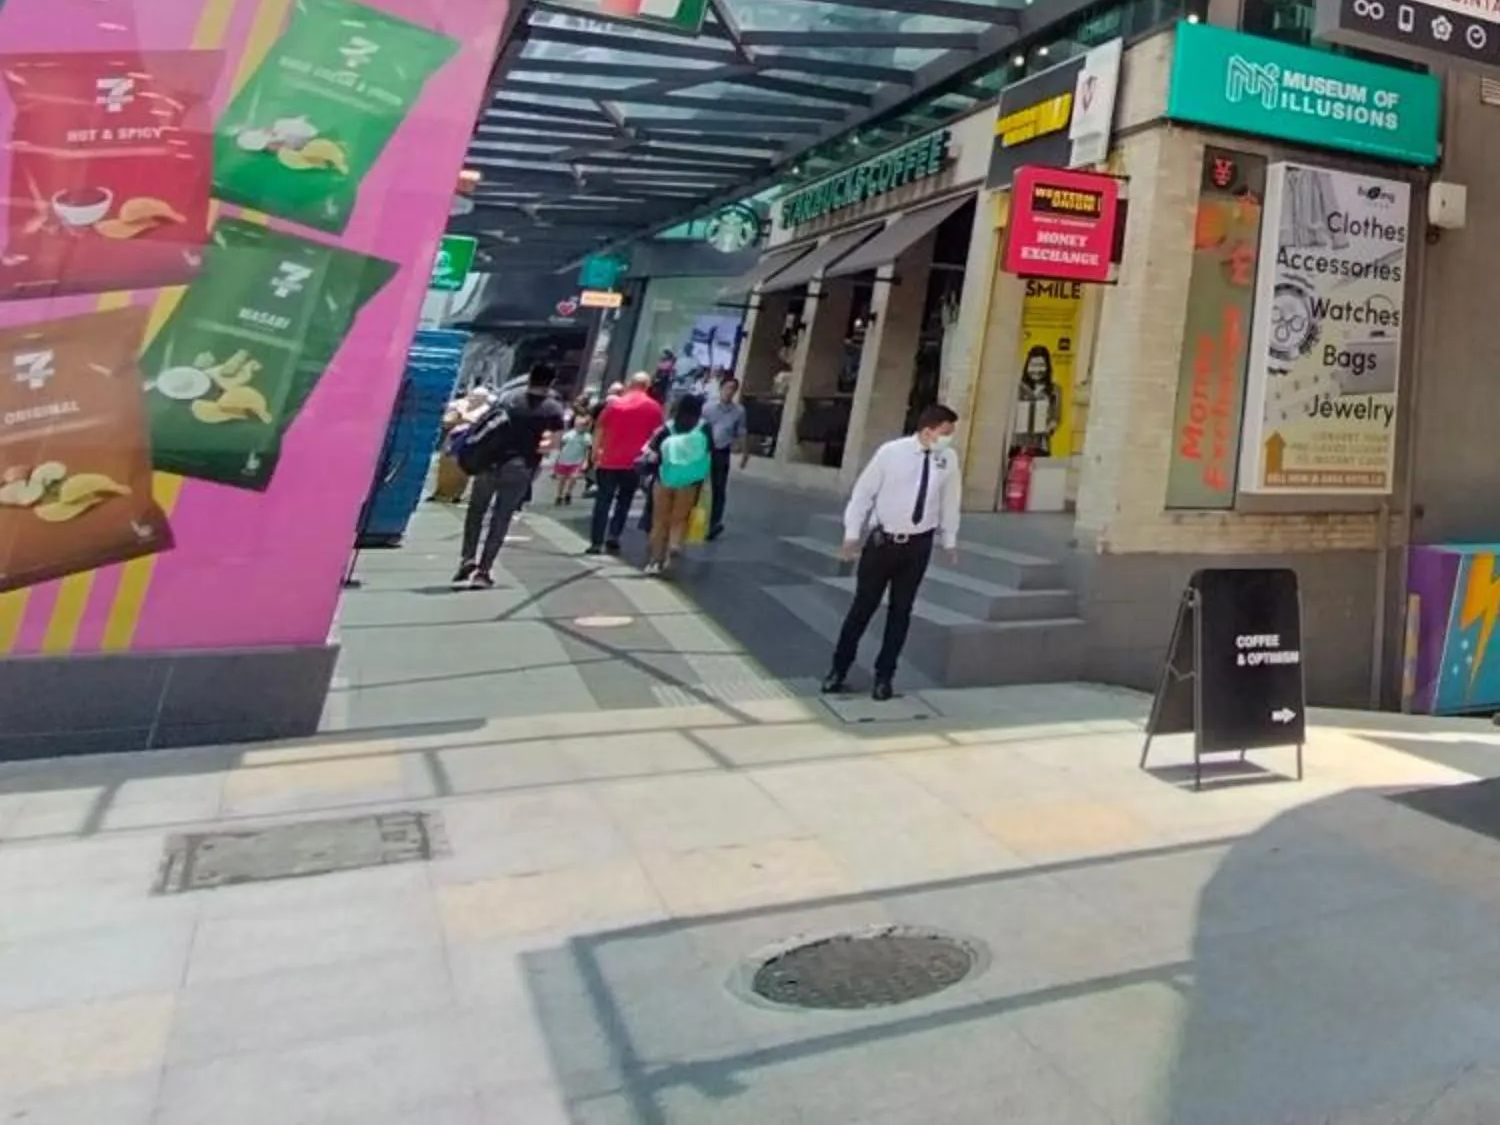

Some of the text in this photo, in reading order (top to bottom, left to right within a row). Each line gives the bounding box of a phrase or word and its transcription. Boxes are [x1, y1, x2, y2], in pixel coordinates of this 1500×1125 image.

[1282, 69, 1400, 109] MUSEUM OF
[1280, 91, 1399, 131] ILLUSIONS
[66, 129, 98, 143] HOT
[117, 126, 163, 141] SPICY
[1036, 230, 1089, 247] MONEY
[1326, 210, 1406, 244] Clothes
[1021, 246, 1100, 266] EXCHANGE
[1276, 245, 1402, 283] Accessories
[1025, 279, 1081, 300] SMILE
[1309, 296, 1401, 327] Watches
[1322, 344, 1377, 376] Bags
[4, 400, 80, 426] ORIGINAL
[1308, 394, 1395, 428] Jewelry
[1235, 634, 1280, 649] COFFEE
